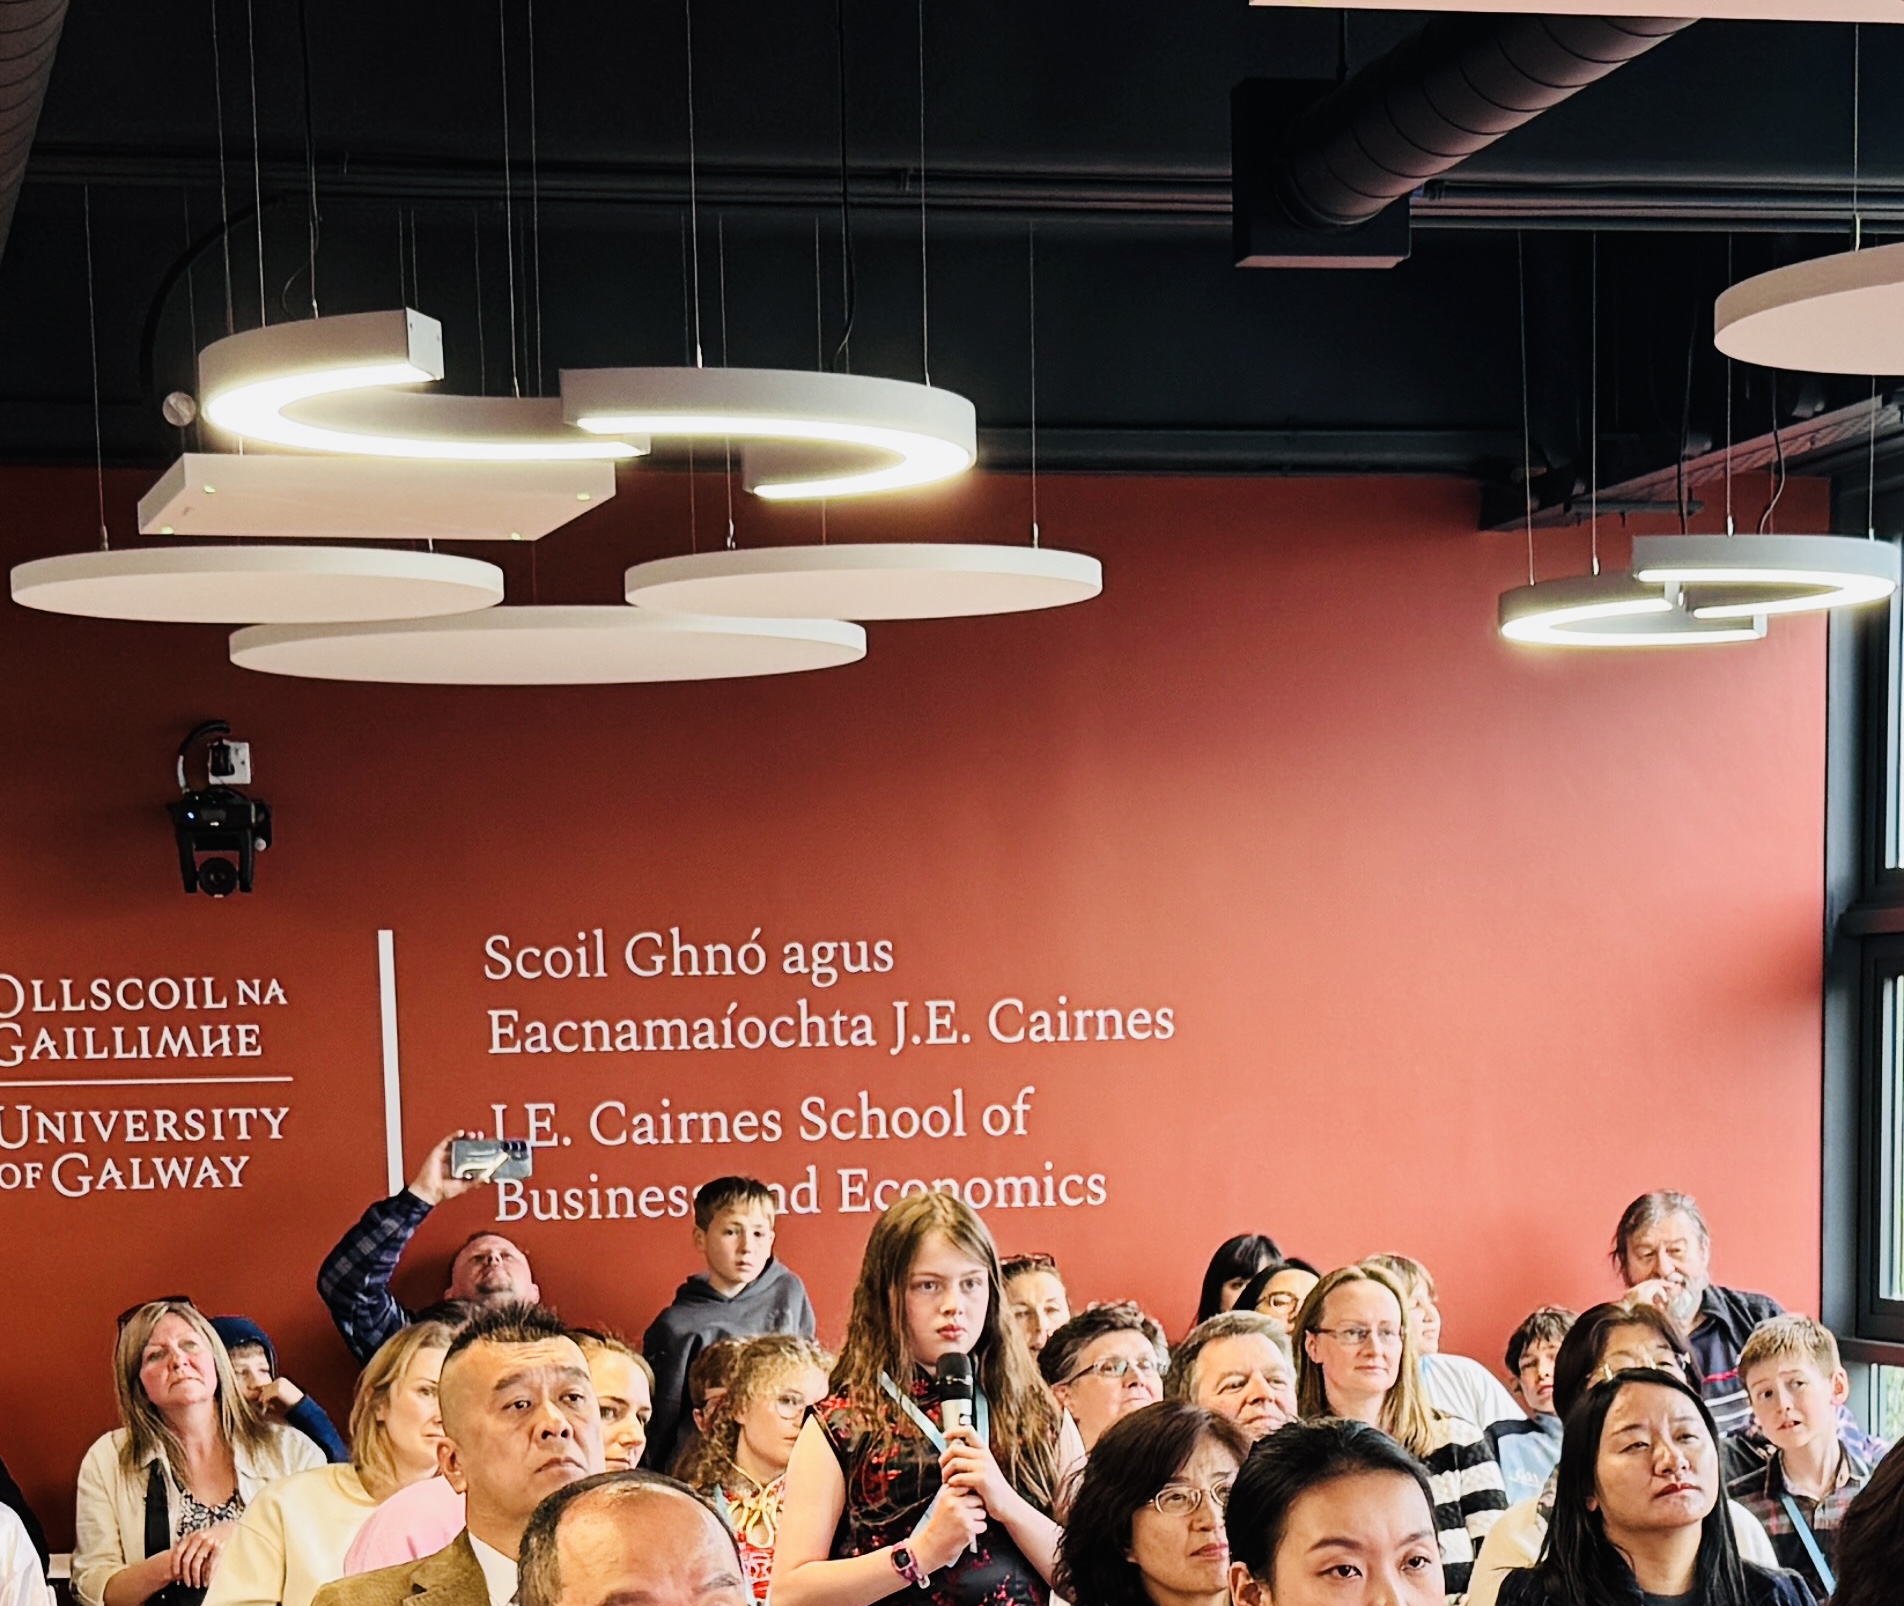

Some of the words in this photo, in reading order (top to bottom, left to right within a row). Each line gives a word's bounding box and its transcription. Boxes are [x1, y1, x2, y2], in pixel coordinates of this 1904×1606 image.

[483, 928, 608, 980] Scoil
[624, 926, 767, 977] Ghnó
[782, 939, 894, 988] agus
[236, 978, 289, 1006] NA
[487, 997, 877, 1054] Eacnamaíochta
[889, 999, 971, 1056] J.E.
[988, 995, 1176, 1044] Cairnes
[589, 1098, 783, 1146] Cairnes
[799, 1088, 967, 1142] School
[982, 1086, 1036, 1137] of
[51, 1152, 250, 1198] GALWAY
[494, 1172, 702, 1222] Busines
[767, 1164, 822, 1214] nd
